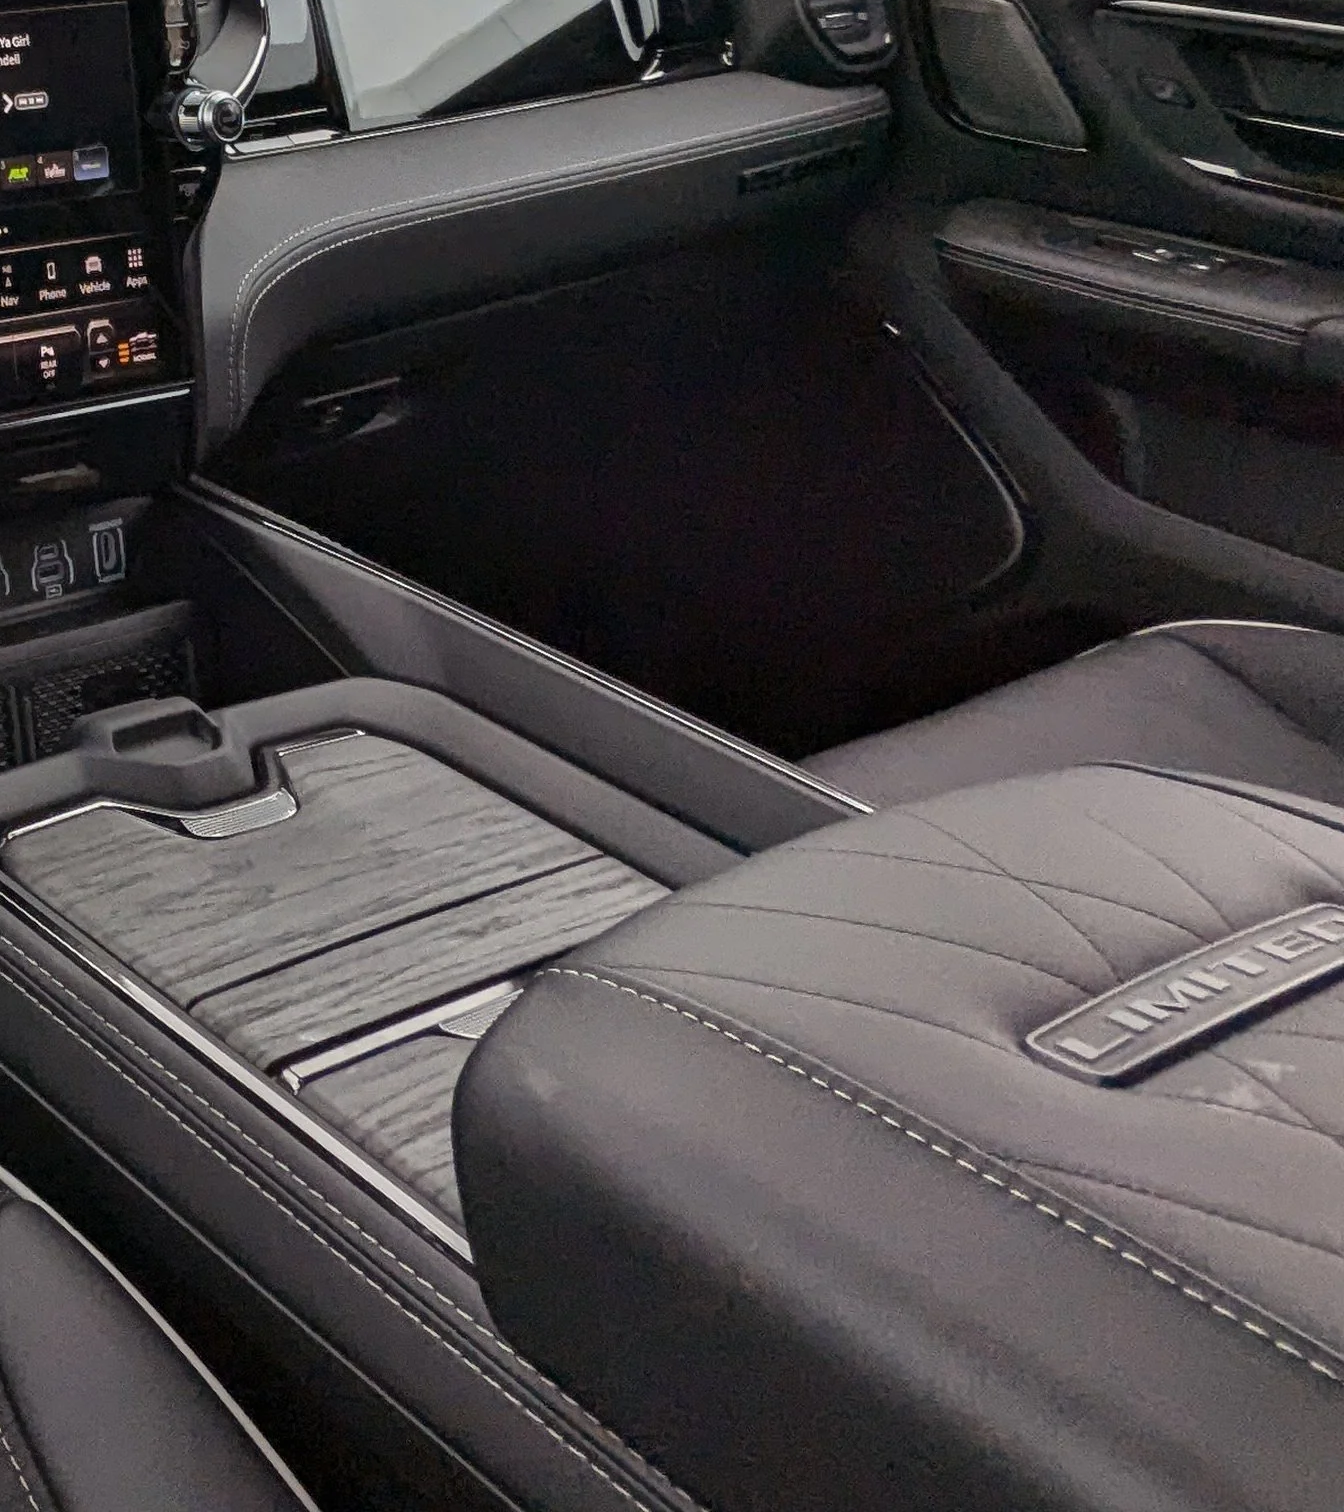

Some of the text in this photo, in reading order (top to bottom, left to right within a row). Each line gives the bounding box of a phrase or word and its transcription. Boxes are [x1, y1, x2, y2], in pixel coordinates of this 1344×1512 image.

[12, 34, 31, 48] Girl
[79, 280, 111, 295] Vehicle
[126, 274, 149, 289] Apps
[39, 287, 67, 301] Phone
[0, 295, 20, 308] Nav
